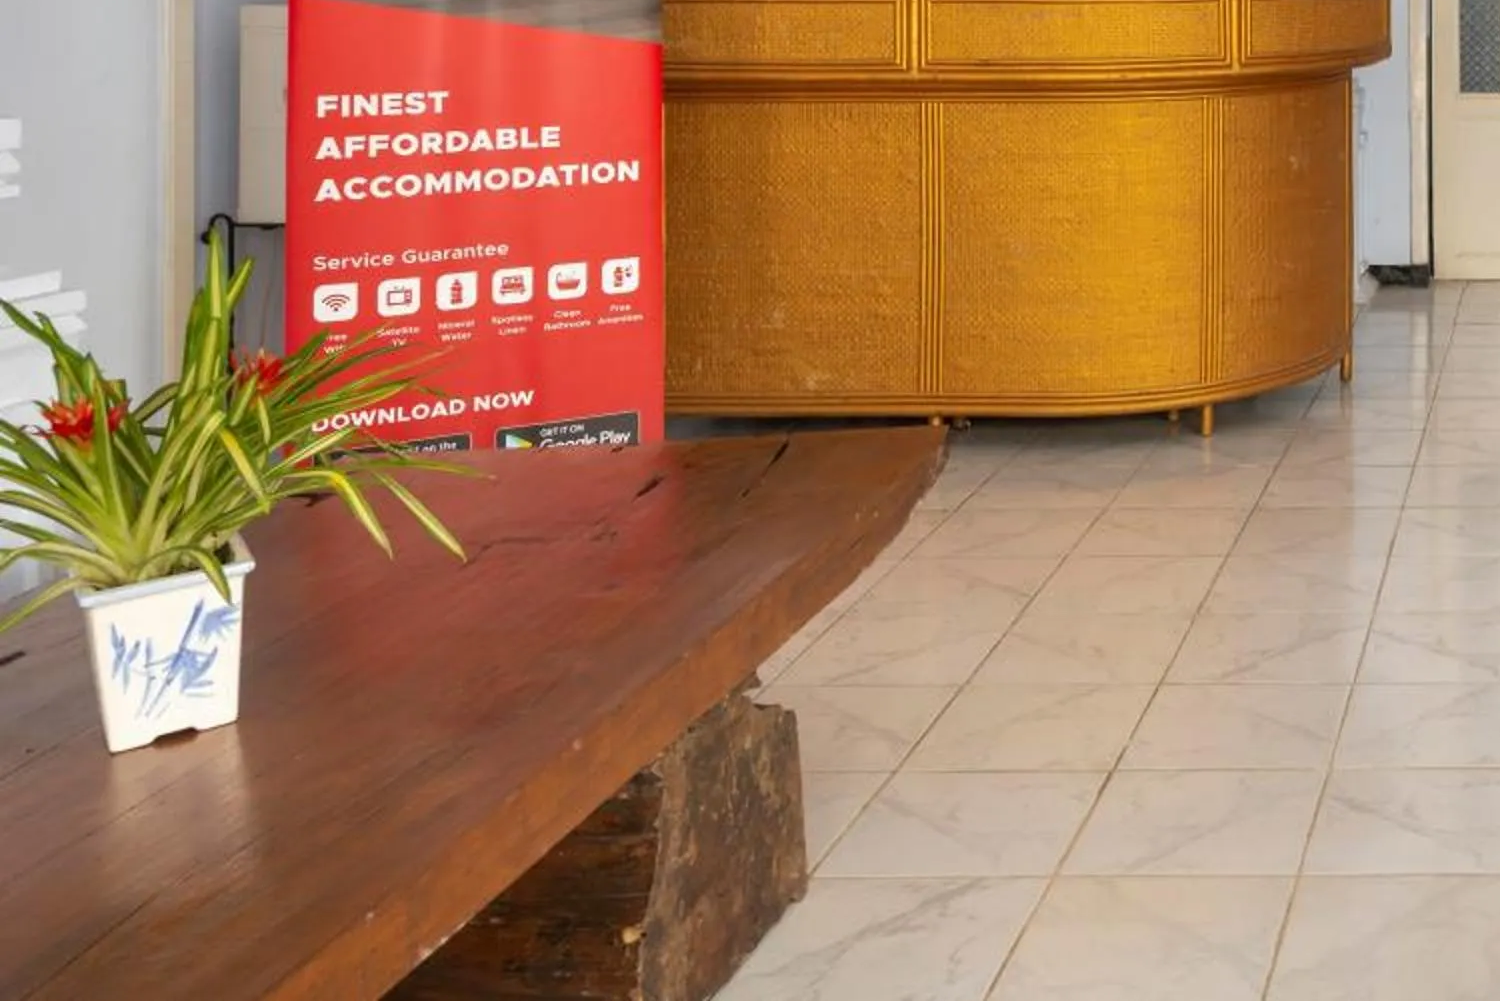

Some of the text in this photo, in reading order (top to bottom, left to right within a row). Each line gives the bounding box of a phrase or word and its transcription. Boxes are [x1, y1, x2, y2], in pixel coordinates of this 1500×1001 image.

[316, 91, 449, 118] FINEST
[315, 126, 561, 160] AFFORDABLE
[314, 160, 640, 202] ACCOMMODATION
[313, 244, 510, 271] Service Guarantee
[390, 338, 407, 347] TV
[440, 332, 472, 342] Water
[311, 390, 535, 432] DOWNLOAD NOW
[539, 424, 585, 437] GET IT ON
[599, 429, 631, 445] Play
